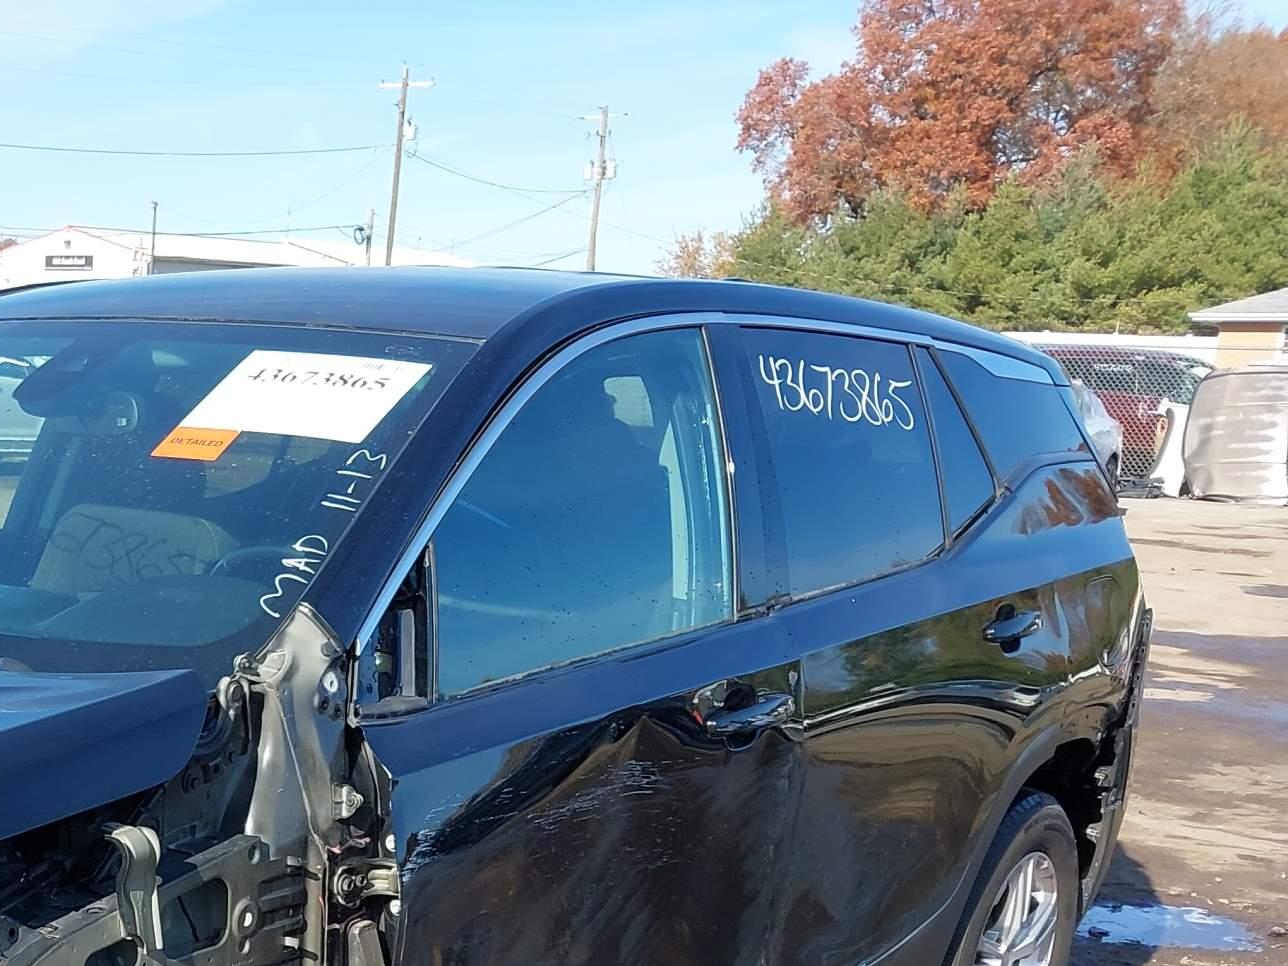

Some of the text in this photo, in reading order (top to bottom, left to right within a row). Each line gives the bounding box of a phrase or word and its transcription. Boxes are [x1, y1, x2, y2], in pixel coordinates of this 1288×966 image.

[248, 367, 393, 391] 43673865
[759, 354, 914, 430] 43673865
[169, 436, 224, 449] DETAILED
[320, 449, 388, 512] 11-13
